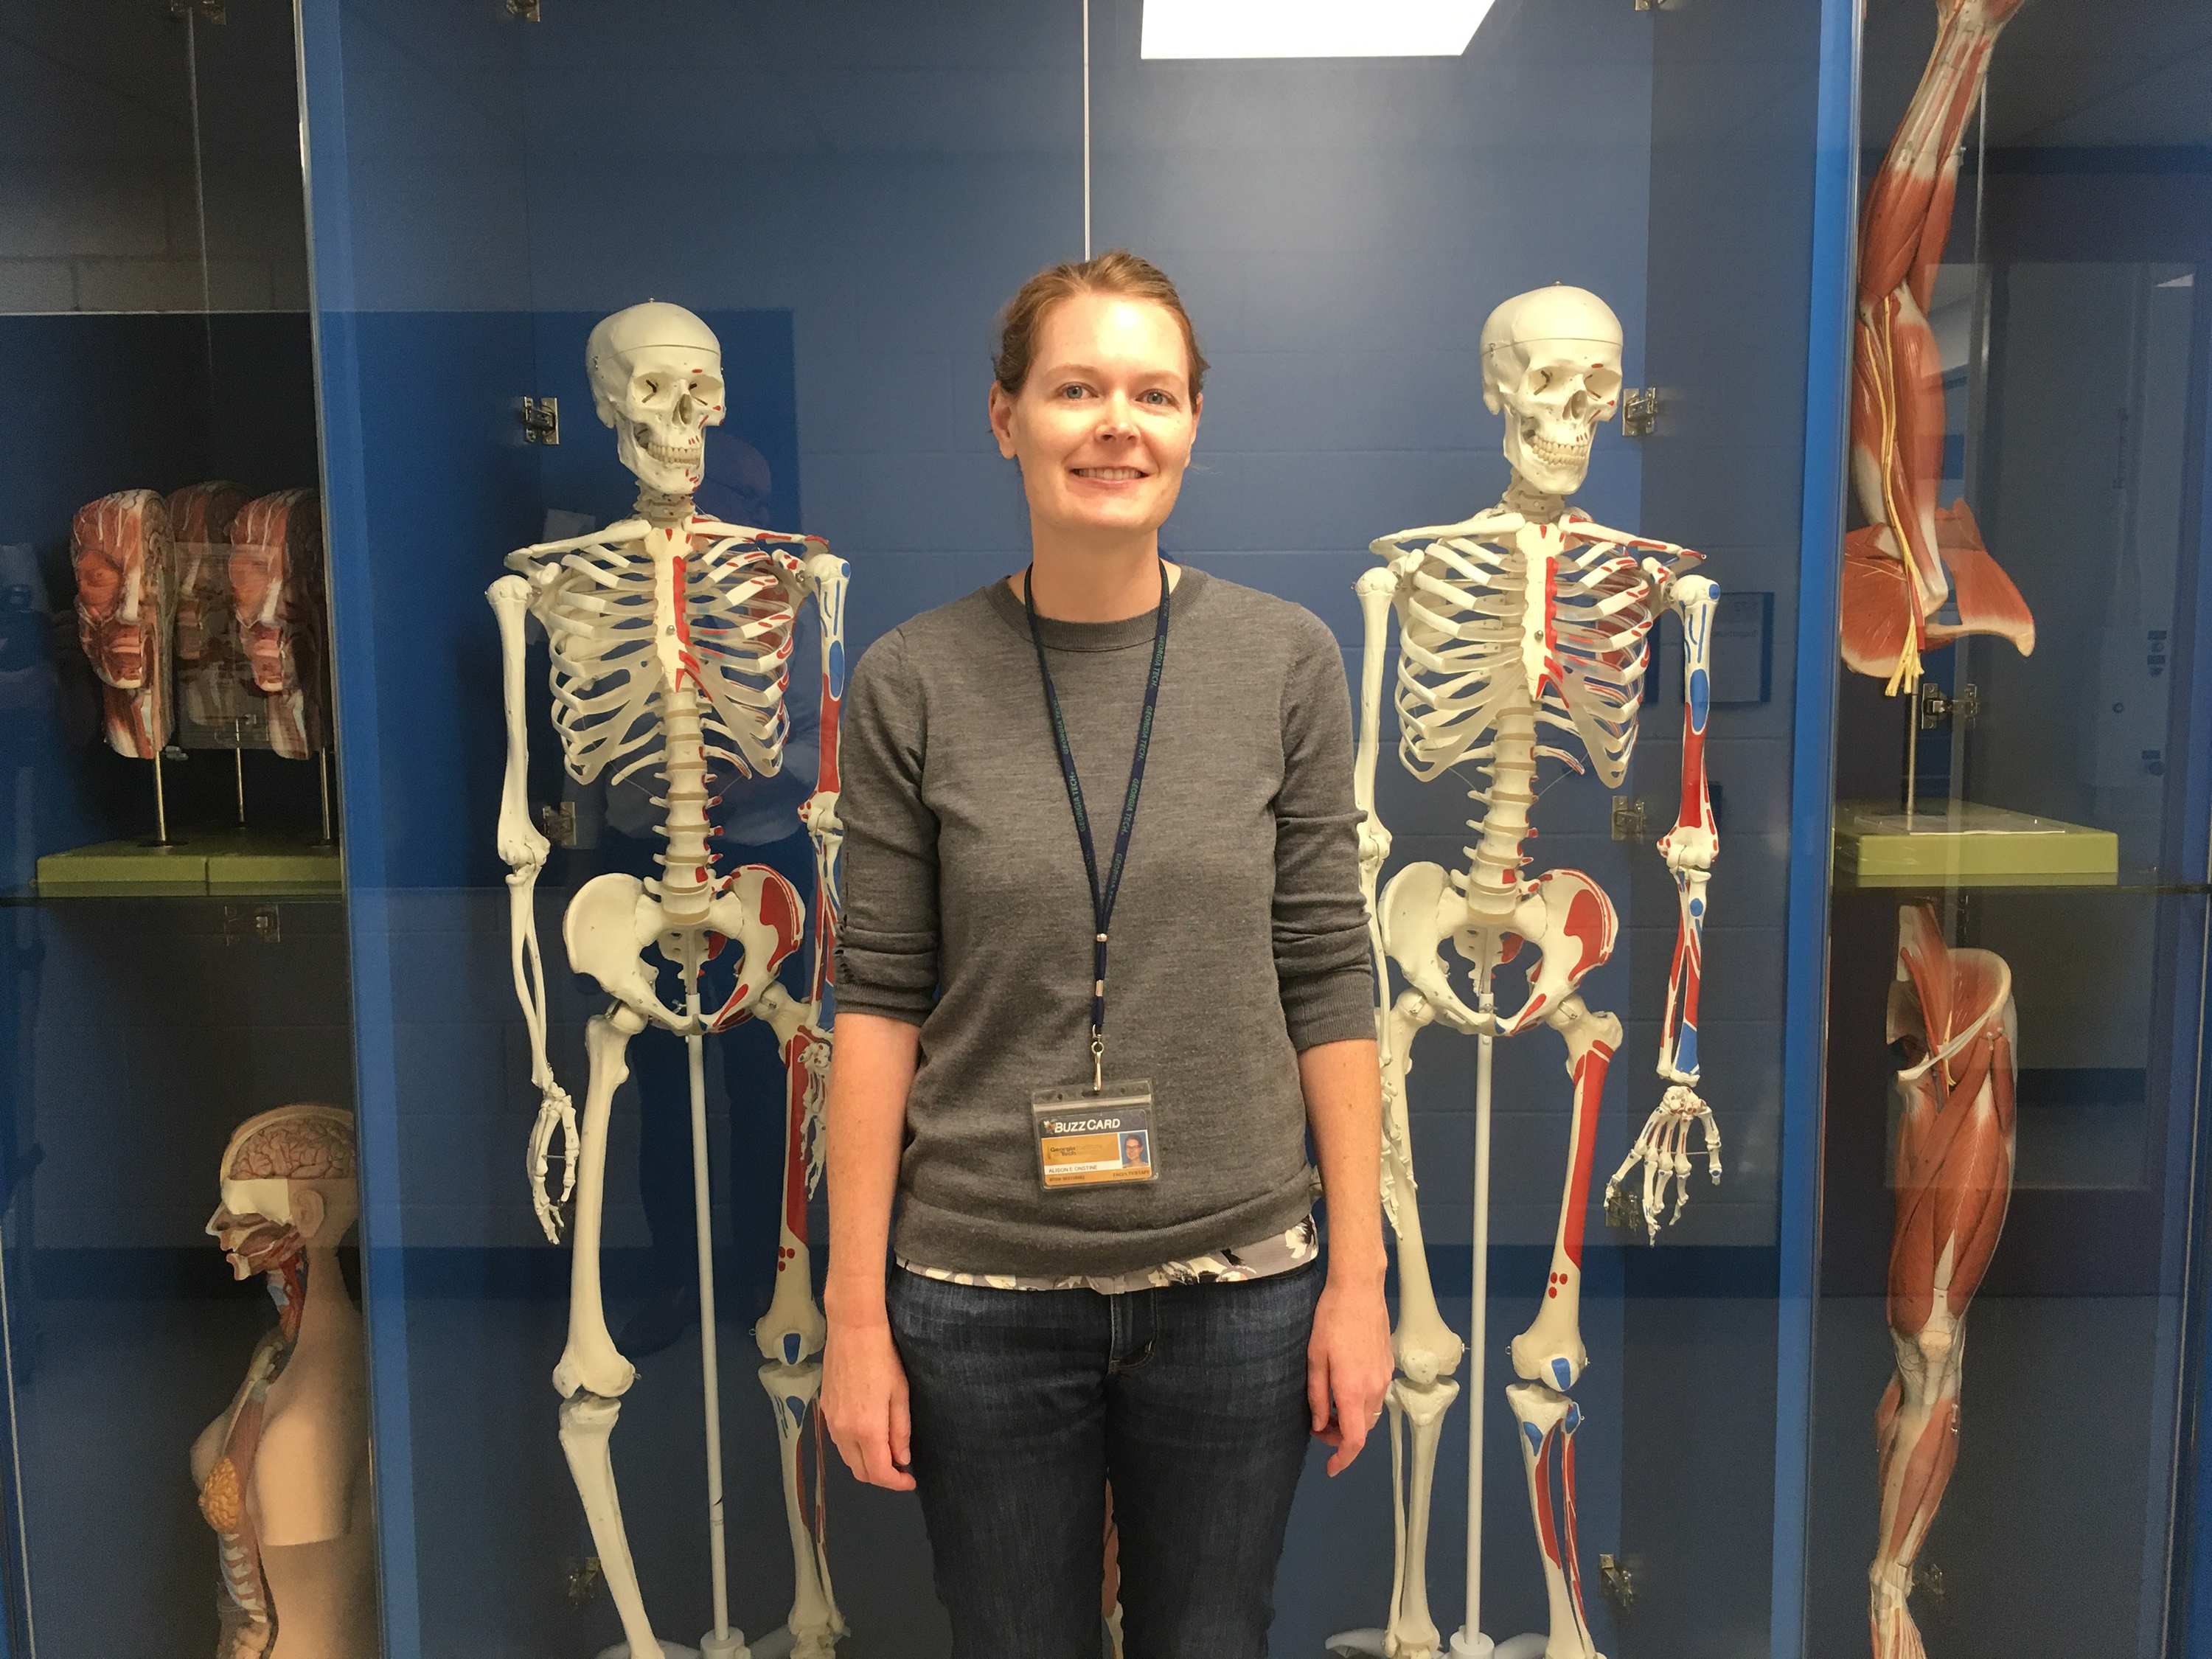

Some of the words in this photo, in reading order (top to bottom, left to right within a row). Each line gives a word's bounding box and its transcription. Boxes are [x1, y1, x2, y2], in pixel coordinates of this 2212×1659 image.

[1155, 635, 1166, 667] GEORGIA
[1150, 667, 1161, 686] TECH
[1057, 720, 1070, 755] GEORGIA
[1141, 705, 1153, 738] GEORGIA
[1138, 740, 1147, 759] TECH
[1068, 774, 1079, 796] TECH
[1127, 778, 1139, 811] GEORGIA
[1073, 796, 1086, 832] GEORGIA
[1121, 813, 1132, 832] TECH
[1110, 853, 1123, 888] GEORGIA
